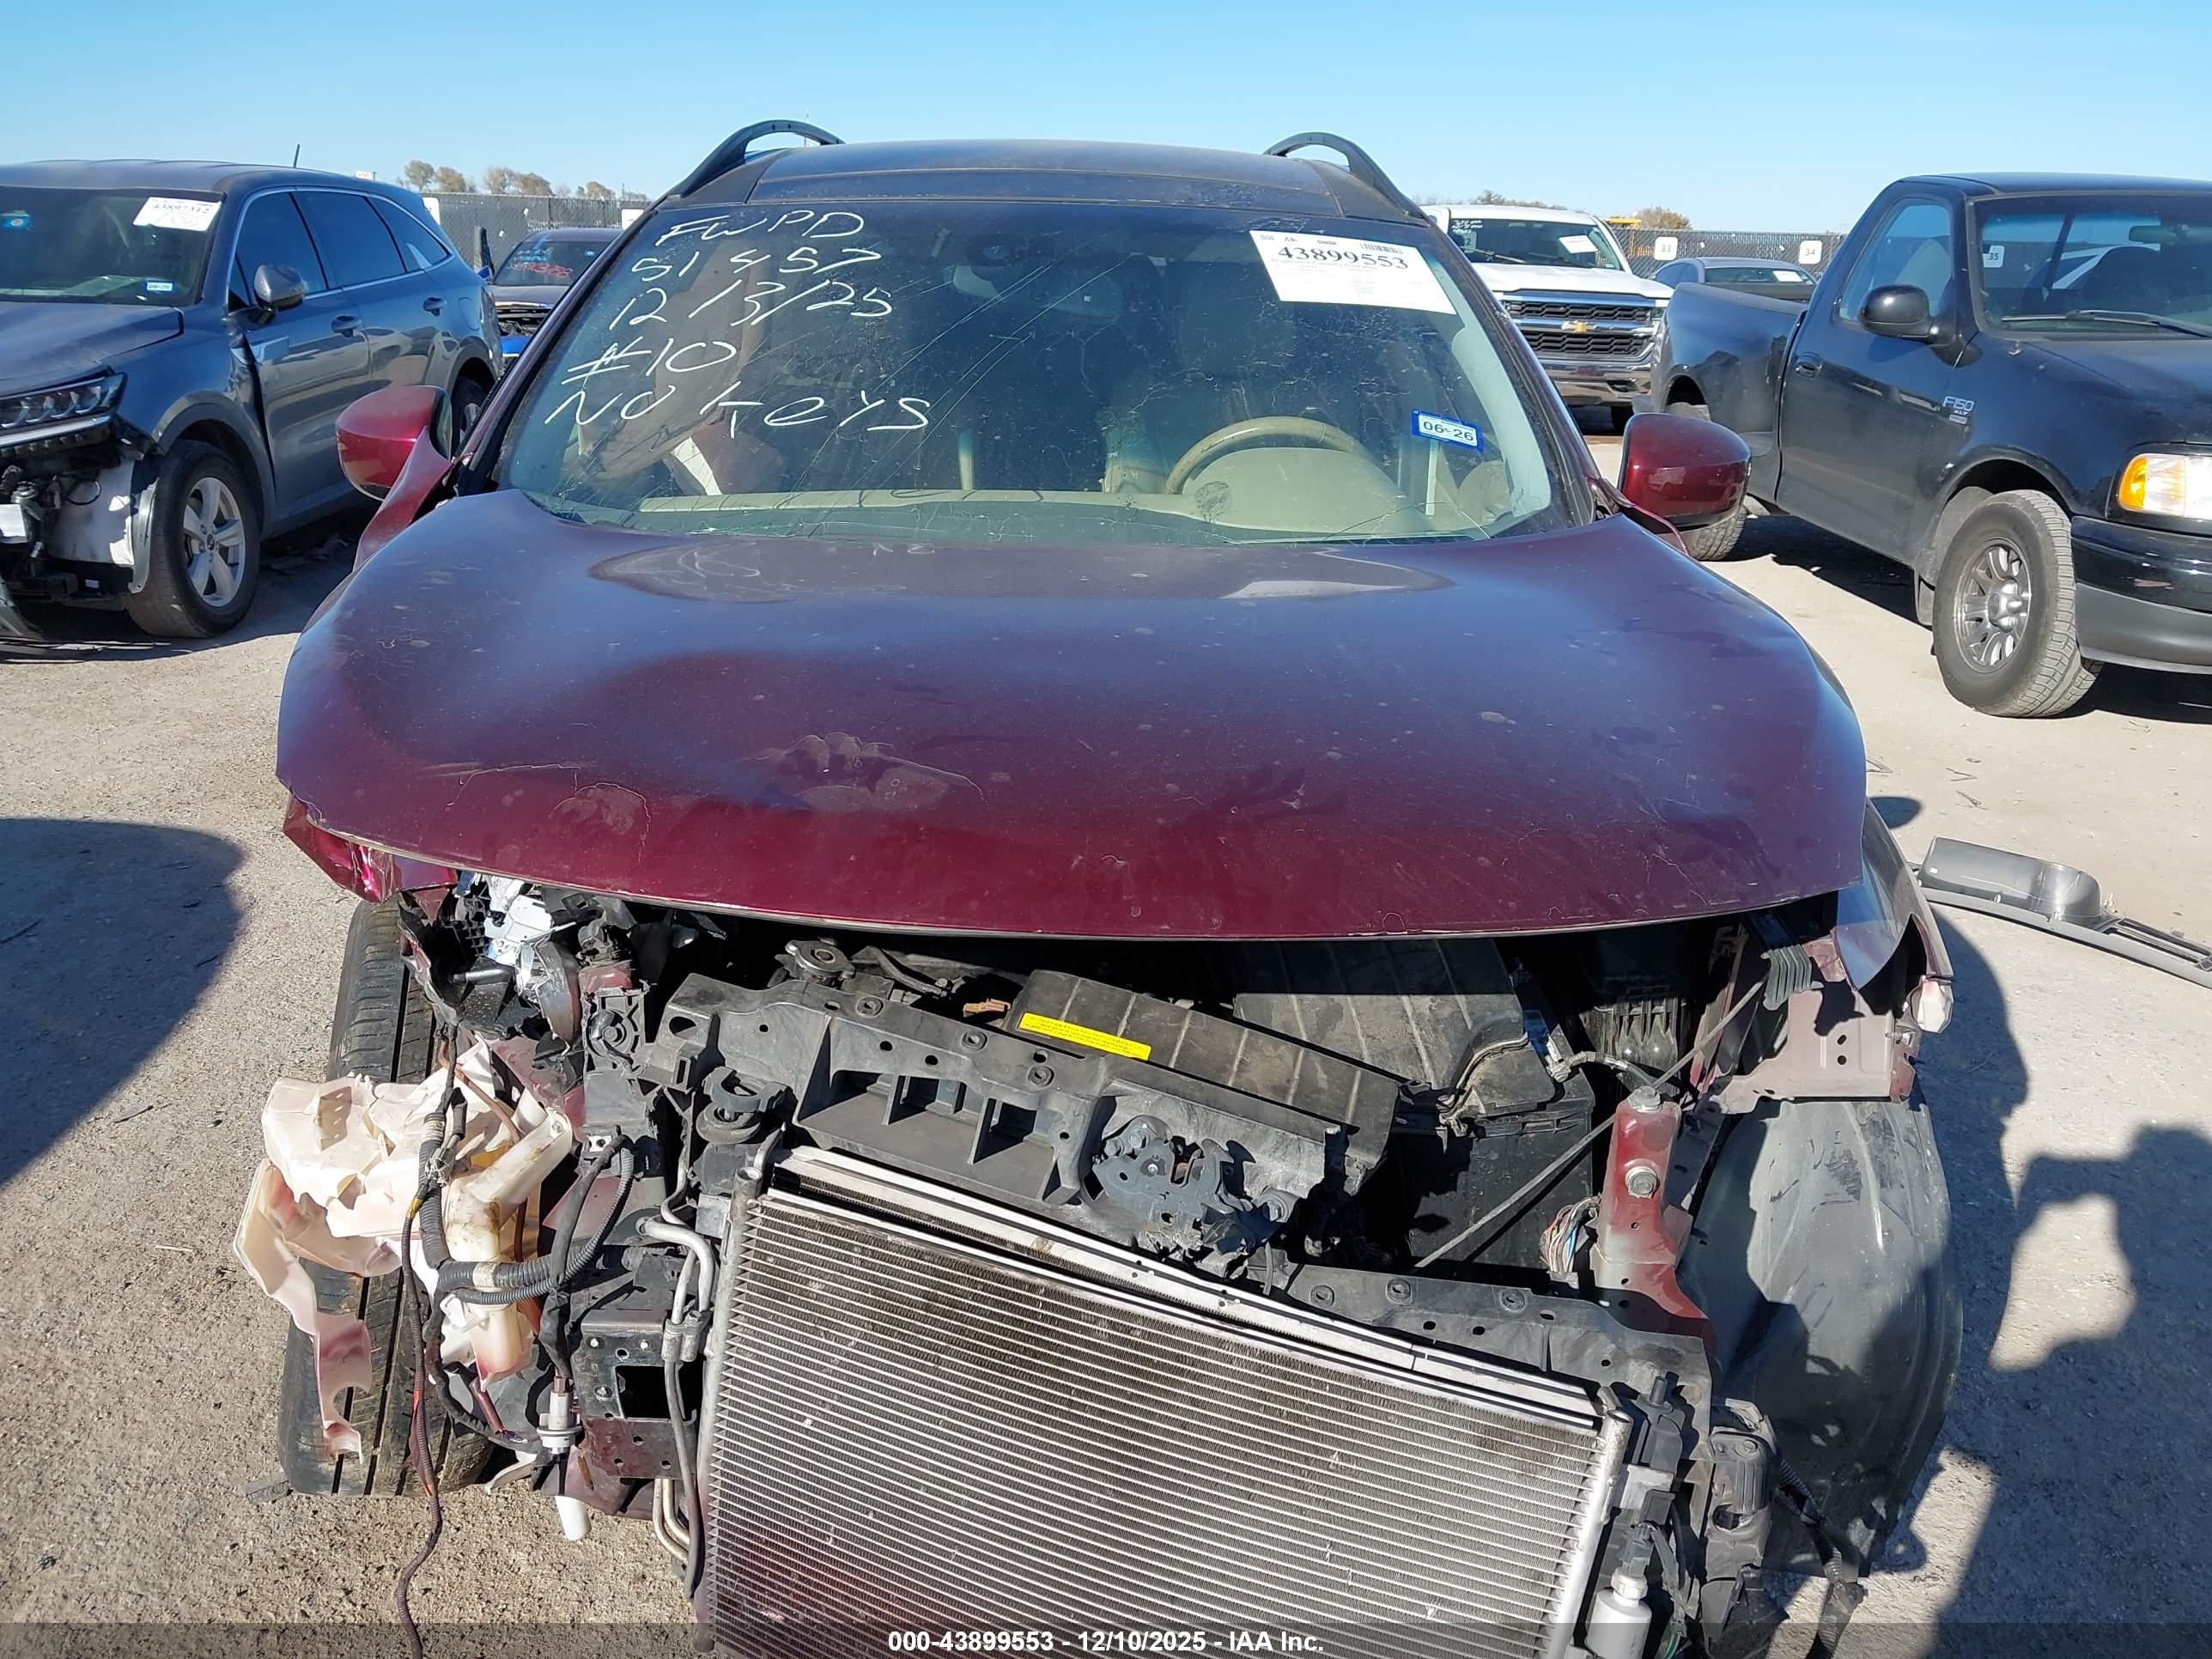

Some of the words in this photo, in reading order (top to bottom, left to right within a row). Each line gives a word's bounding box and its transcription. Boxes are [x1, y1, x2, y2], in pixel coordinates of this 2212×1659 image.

[654, 210, 864, 246] FWPD
[1278, 246, 1409, 270] 43899553
[1804, 247, 1817, 256] 34
[1988, 252, 2000, 261] 35
[561, 337, 738, 386] #10
[1942, 395, 1975, 411] F150
[1423, 421, 1474, 441] 06-26
